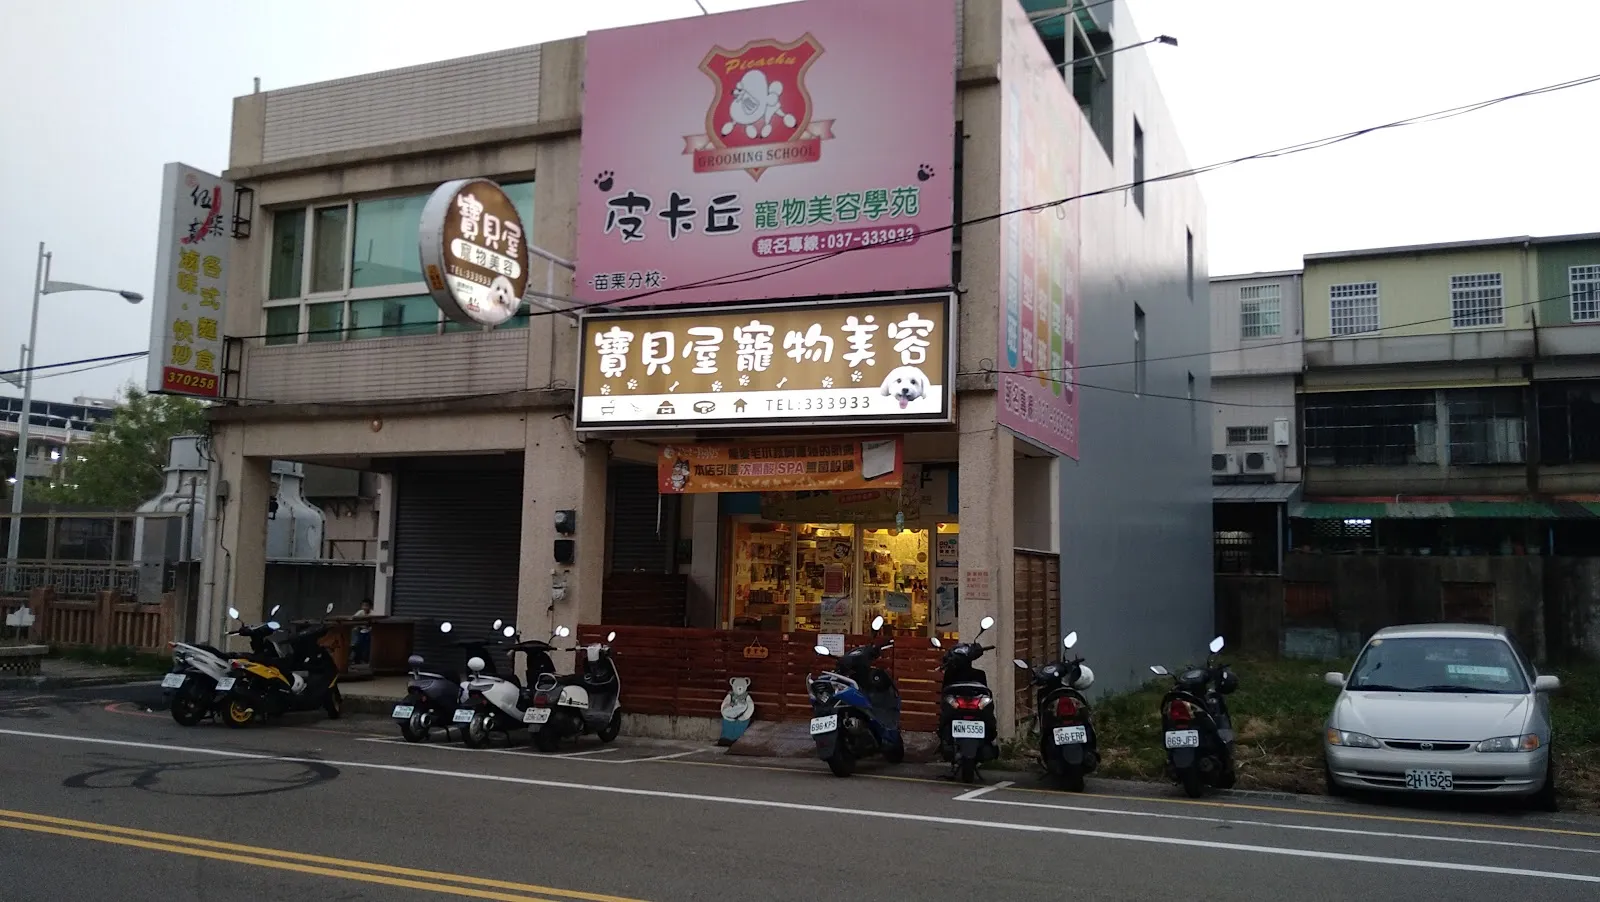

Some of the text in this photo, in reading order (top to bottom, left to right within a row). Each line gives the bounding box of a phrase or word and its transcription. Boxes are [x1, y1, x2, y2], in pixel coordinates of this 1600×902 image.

[725, 51, 797, 74] Picachu
[698, 145, 816, 168] GROOMING SCHOOL
[604, 189, 742, 241] 皮卡丘
[754, 187, 919, 230] 寵物美容學苑
[457, 193, 522, 258] 寶貝屋
[594, 312, 935, 378] 寶貝屋寵物美容
[167, 372, 215, 390] 370258
[811, 719, 837, 732] 696-KPS
[953, 724, 984, 735] MQN-5358
[1055, 731, 1085, 743] 366-ERP
[1406, 774, 1453, 788] 2H-1525
